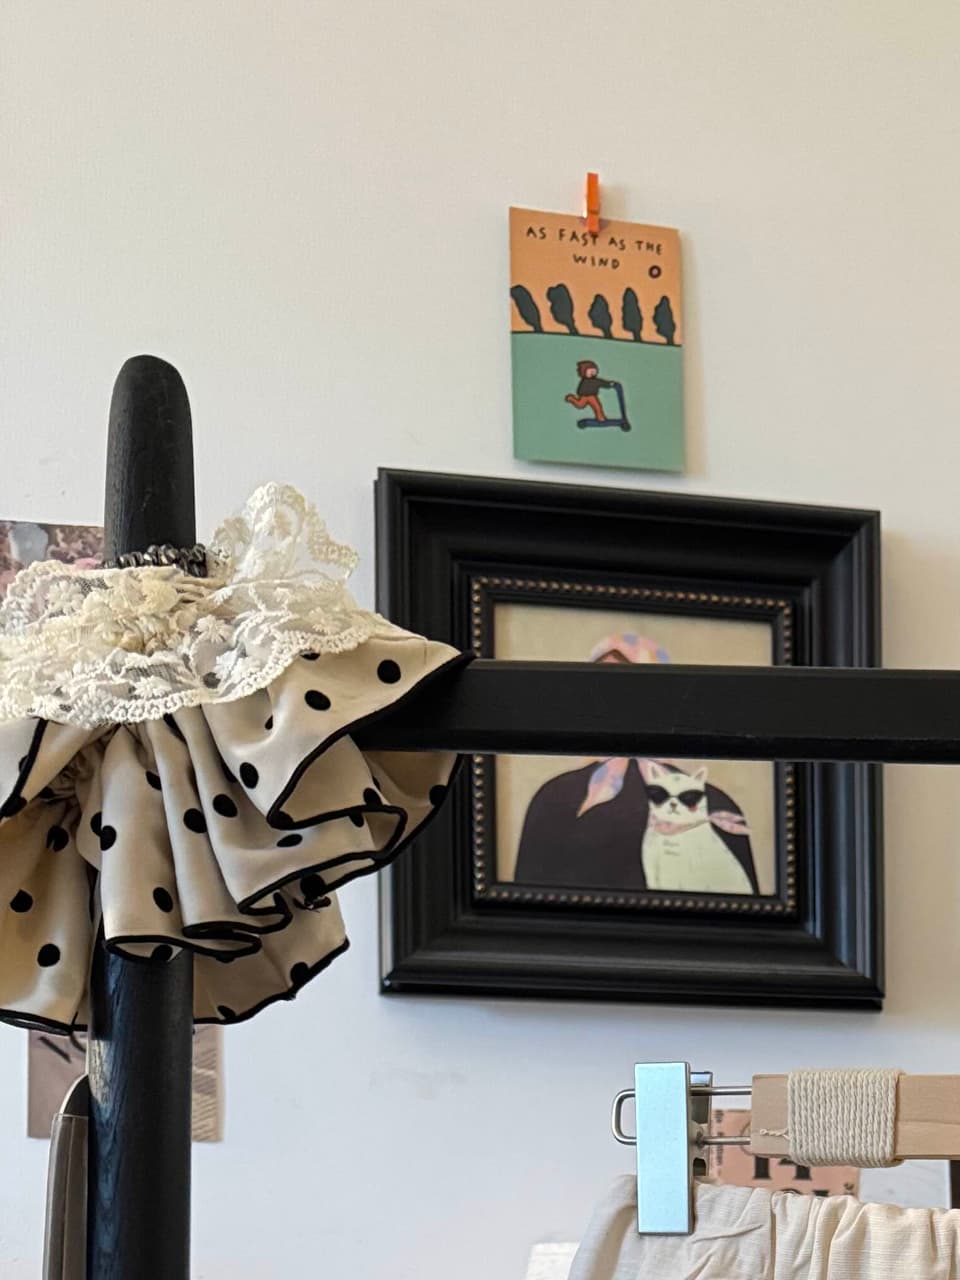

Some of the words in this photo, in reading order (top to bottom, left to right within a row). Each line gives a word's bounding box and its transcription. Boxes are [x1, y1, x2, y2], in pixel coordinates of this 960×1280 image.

[526, 226, 547, 240] AS
[558, 229, 599, 247] FAST
[608, 236, 625, 250] AS
[635, 240, 663, 255] THE
[573, 253, 620, 269] WIND
